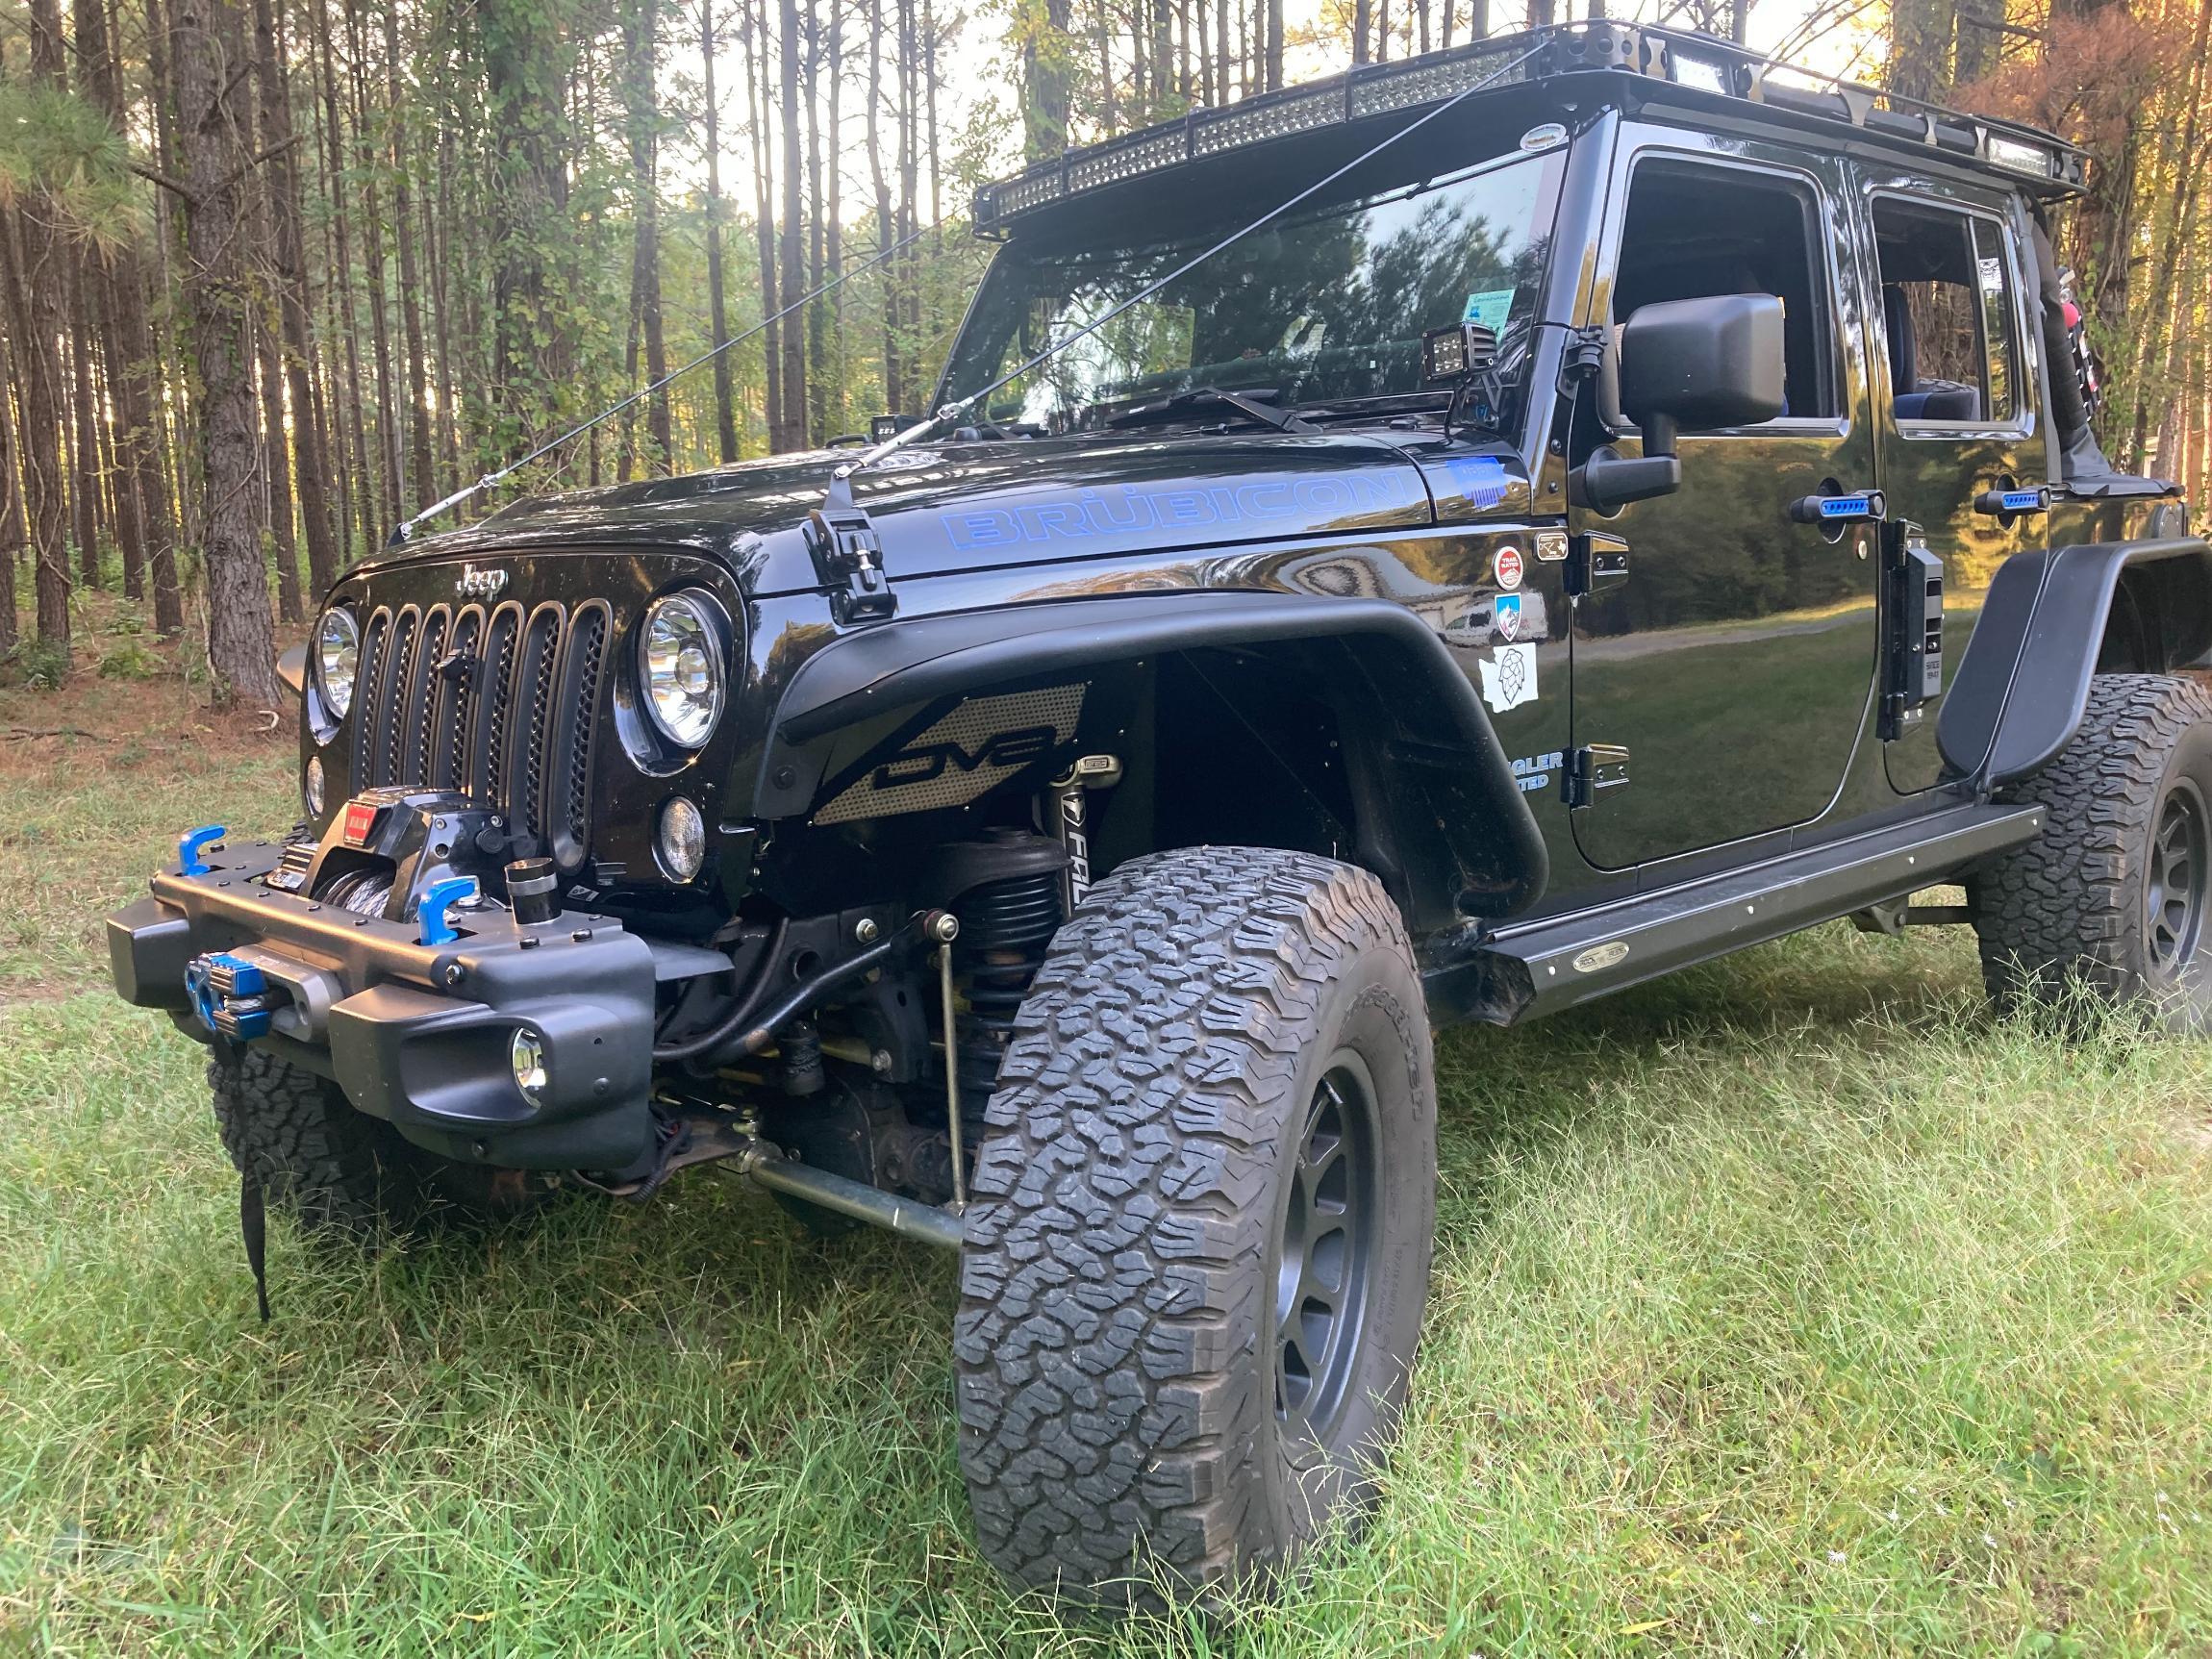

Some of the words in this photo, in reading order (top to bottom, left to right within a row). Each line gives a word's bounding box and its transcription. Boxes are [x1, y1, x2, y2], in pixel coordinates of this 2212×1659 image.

[454, 563, 509, 602] Jeep
[1508, 751, 1564, 776] GLER
[1516, 774, 1549, 792] TED
